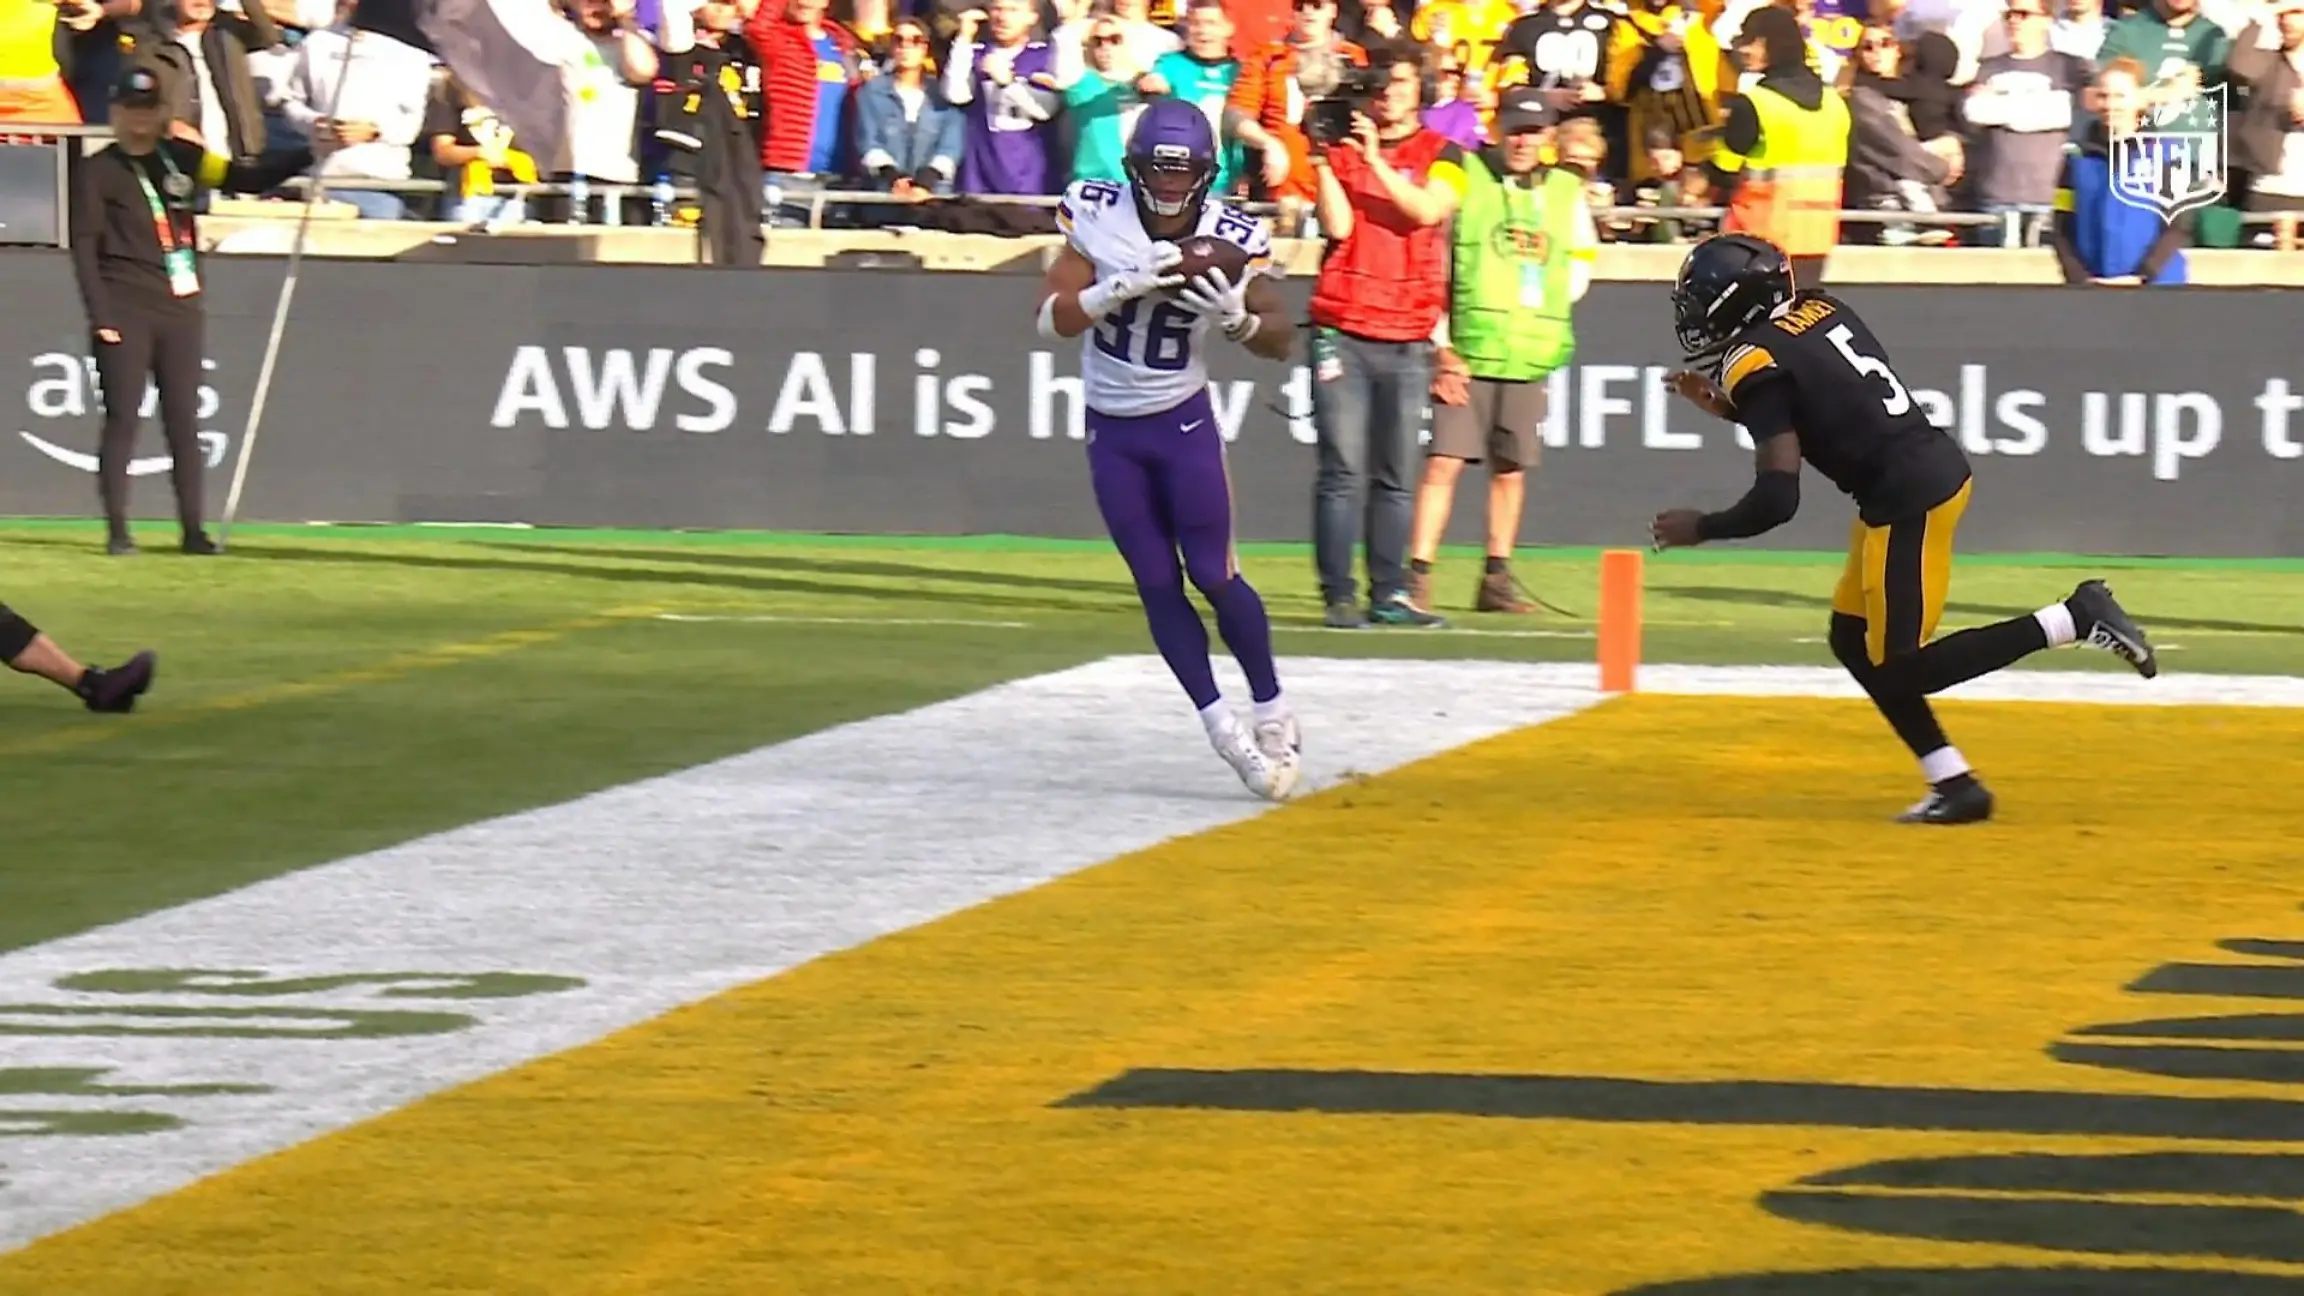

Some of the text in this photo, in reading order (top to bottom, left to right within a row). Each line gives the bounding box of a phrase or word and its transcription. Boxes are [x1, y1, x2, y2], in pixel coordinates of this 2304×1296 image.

[1094, 298, 1194, 370] 36
[1824, 323, 1910, 415] 5
[490, 346, 738, 433] AWS
[767, 351, 876, 435] AI
[914, 348, 997, 438] is
[2082, 391, 2223, 480] up
